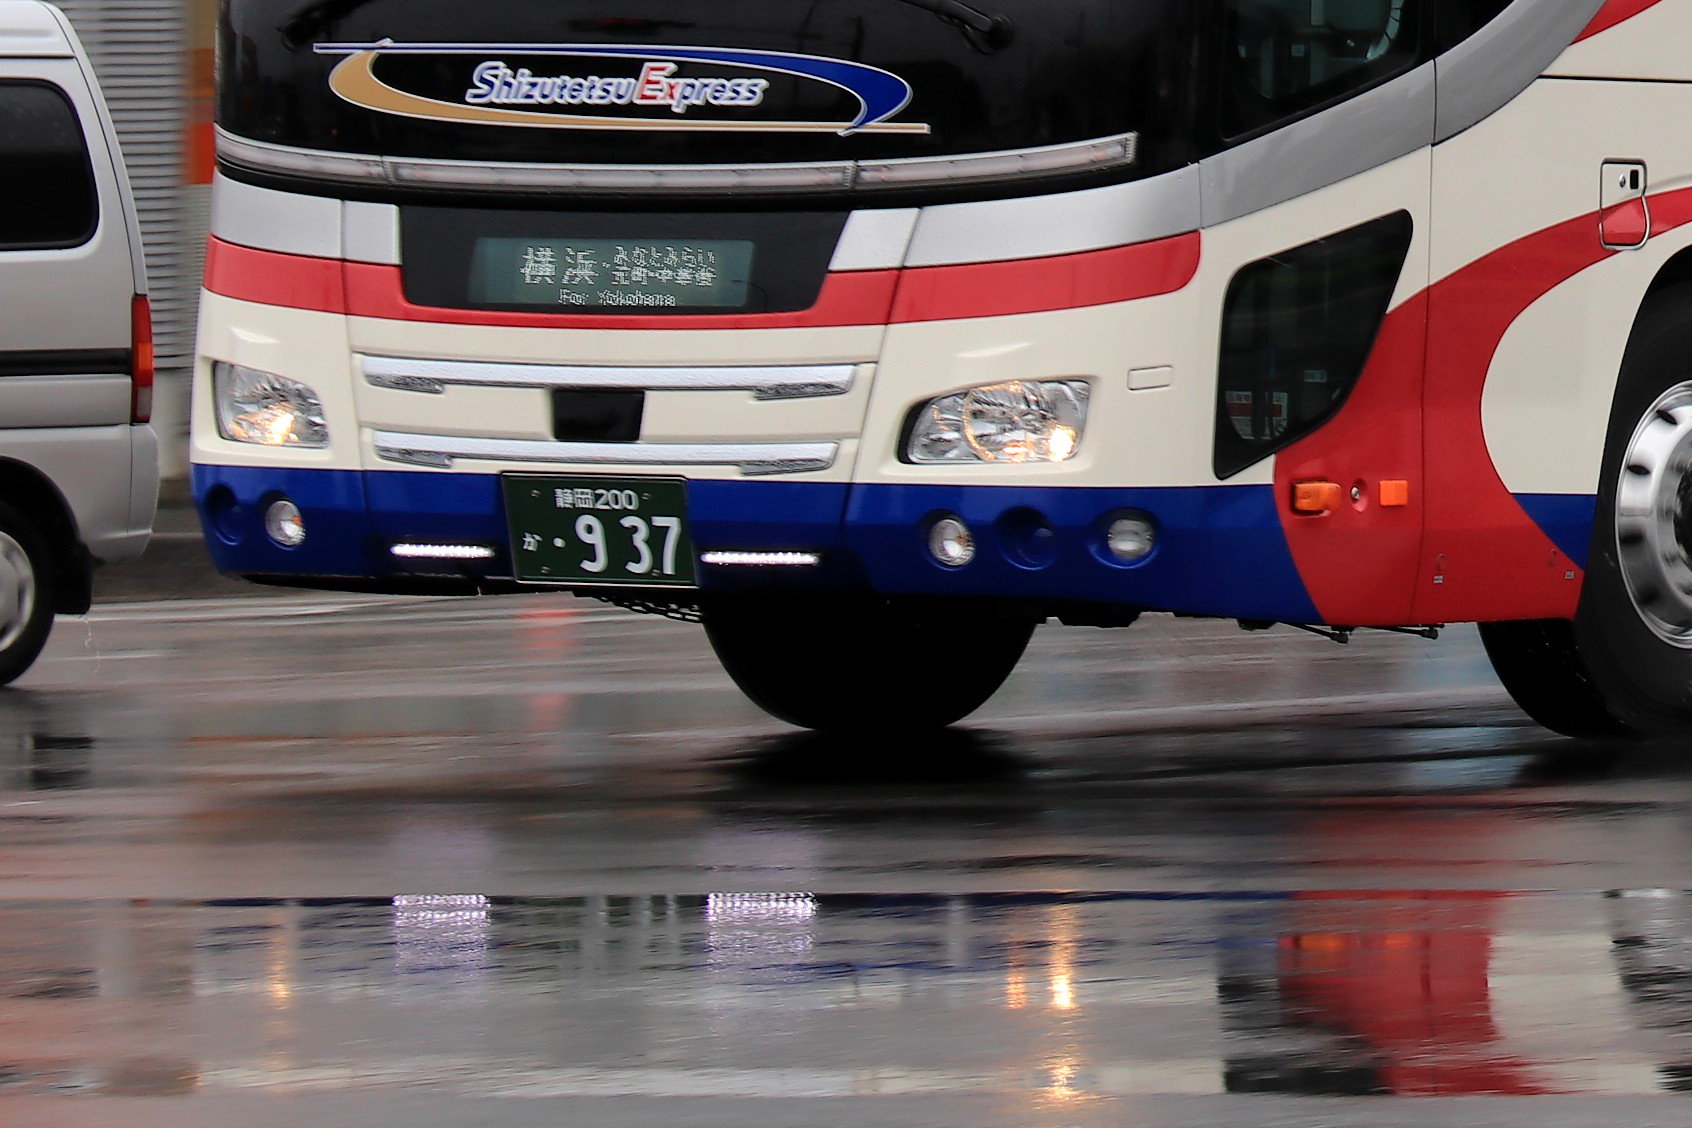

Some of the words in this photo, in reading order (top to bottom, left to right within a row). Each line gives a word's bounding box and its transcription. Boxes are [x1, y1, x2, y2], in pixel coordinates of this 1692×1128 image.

[466, 61, 635, 104] Shizutetsu
[633, 62, 769, 113] Express
[558, 288, 589, 306] For
[597, 289, 676, 306] Yokohama
